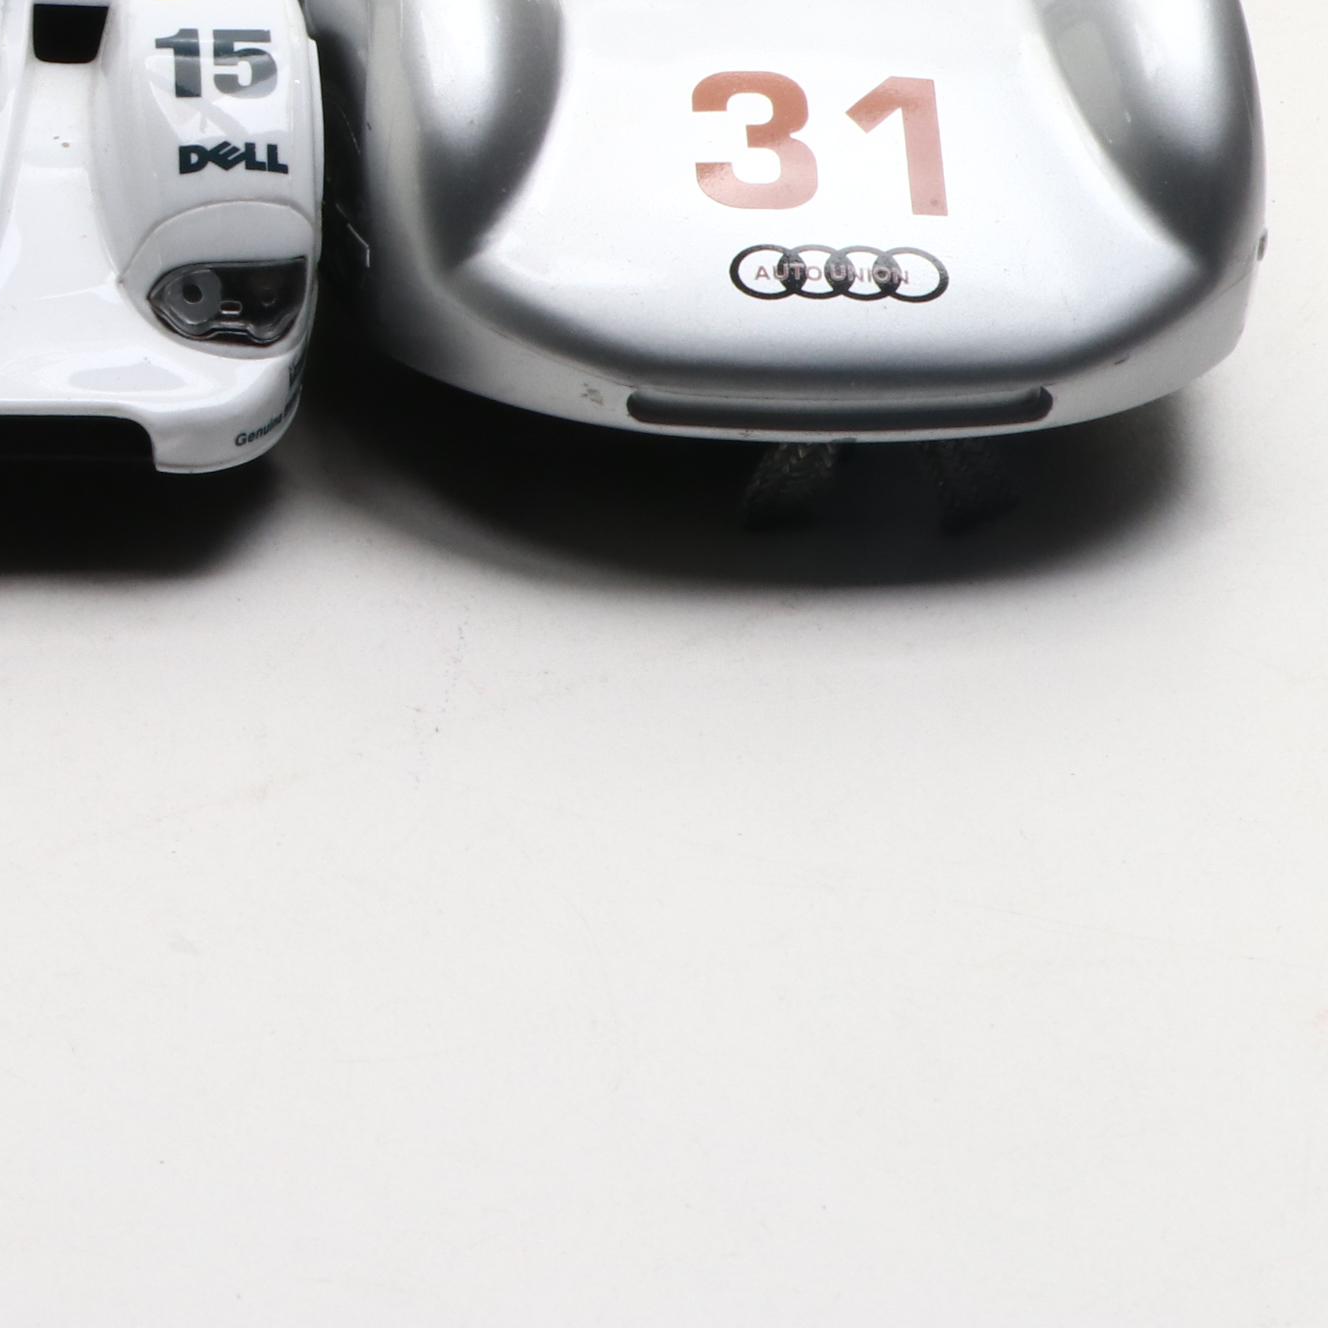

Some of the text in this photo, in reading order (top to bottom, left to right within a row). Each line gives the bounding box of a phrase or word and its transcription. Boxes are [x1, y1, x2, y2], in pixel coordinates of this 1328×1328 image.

[154, 27, 279, 100] 15
[178, 140, 289, 175] DELL
[691, 70, 949, 217] 31
[755, 262, 910, 285] AUTO UNION
